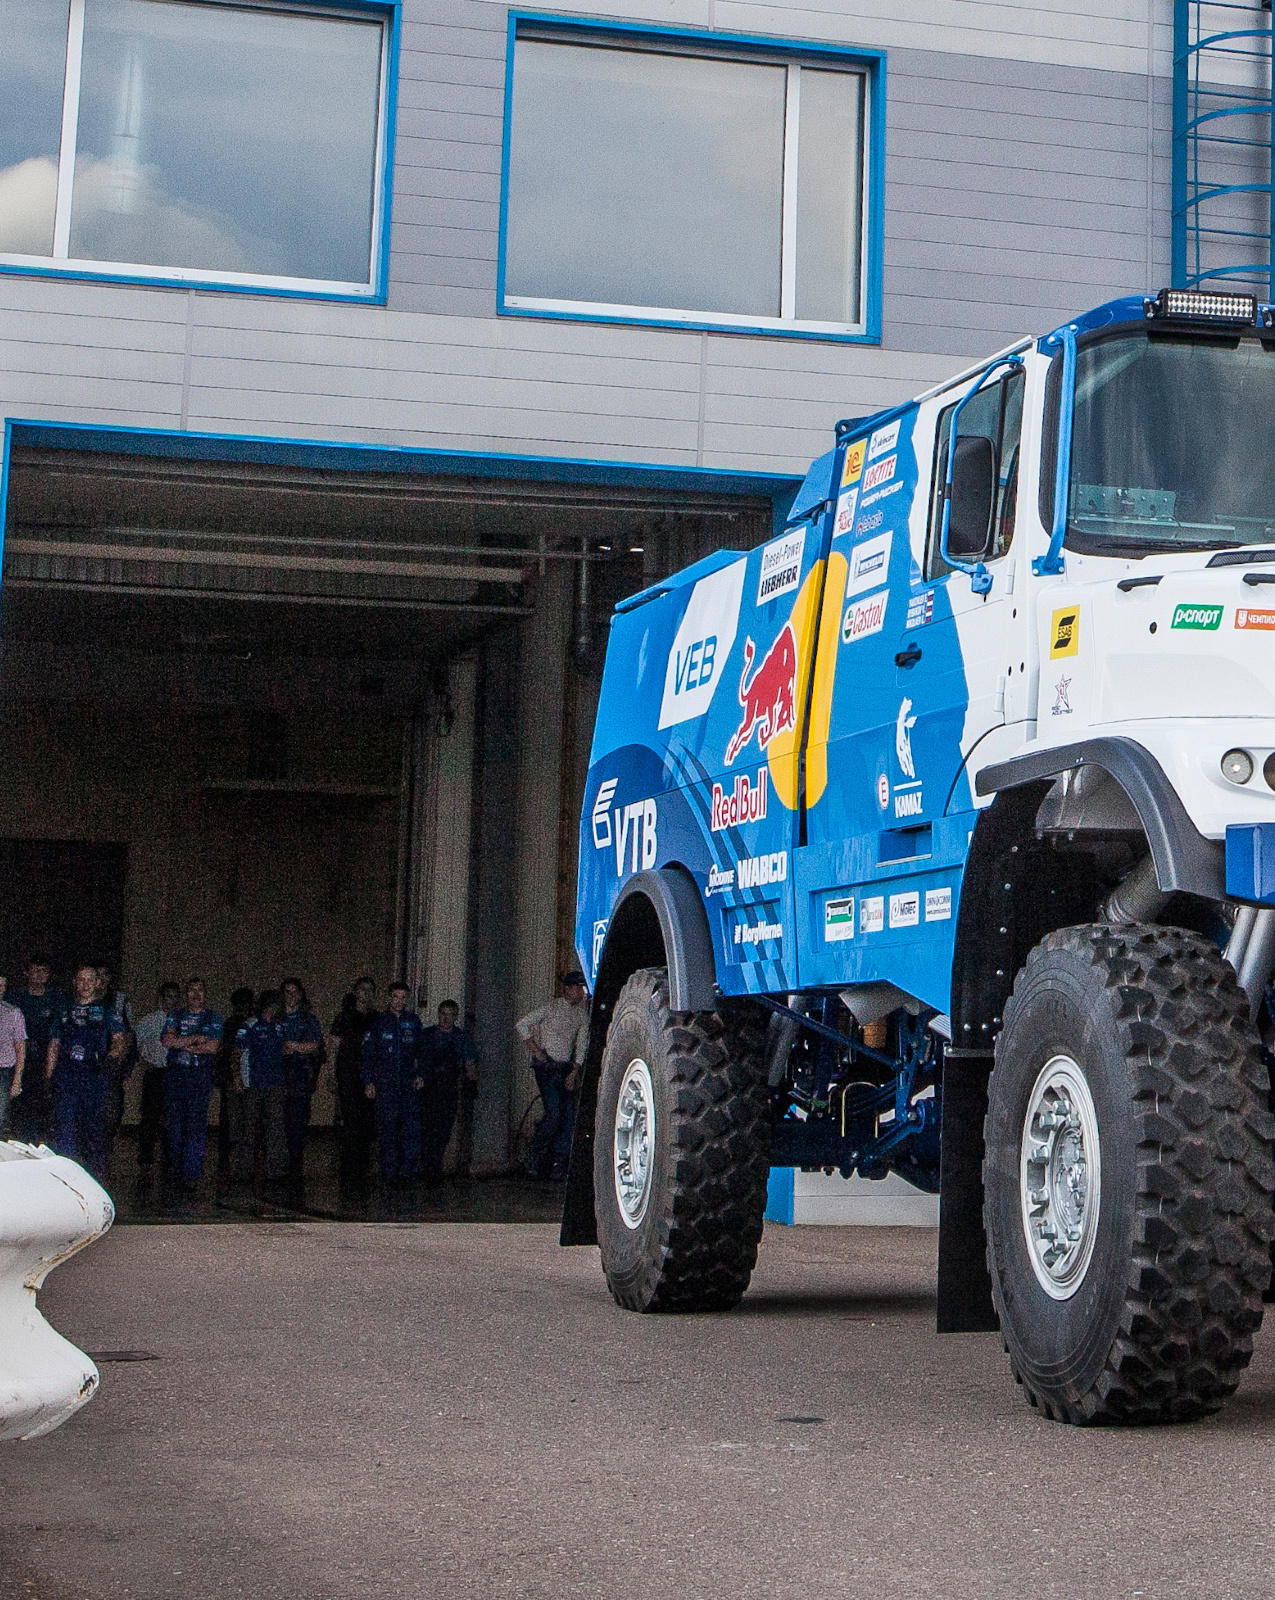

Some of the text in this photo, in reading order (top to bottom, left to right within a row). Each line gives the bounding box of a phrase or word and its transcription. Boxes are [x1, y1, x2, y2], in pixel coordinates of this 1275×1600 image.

[864, 456, 896, 490] LOCTITE
[760, 564, 798, 597] LIEBHERR
[852, 598, 885, 635] Castrol
[1058, 625, 1072, 639] ESAB
[674, 635, 718, 696] VEB
[711, 766, 768, 832] Red Bull
[894, 792, 923, 819] KAMAZ
[614, 798, 657, 877] VTB
[737, 850, 788, 890] WABCO
[741, 920, 782, 946] BorgWarner
